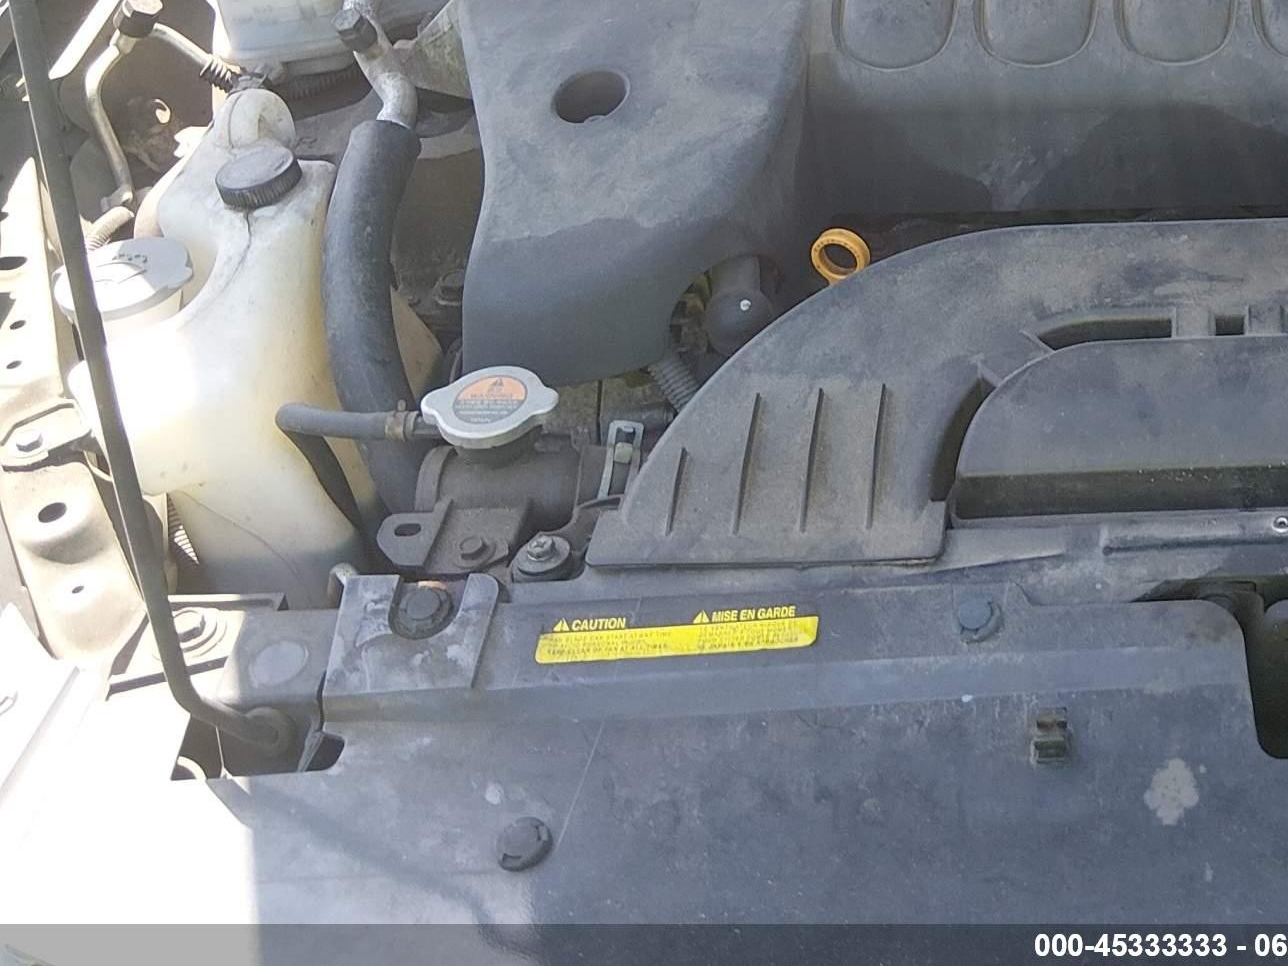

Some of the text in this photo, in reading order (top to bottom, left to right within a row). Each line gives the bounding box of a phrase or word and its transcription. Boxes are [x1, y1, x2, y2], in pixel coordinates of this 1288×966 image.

[711, 605, 797, 622] MISE EN GARDE
[571, 617, 627, 631] CAUTION
